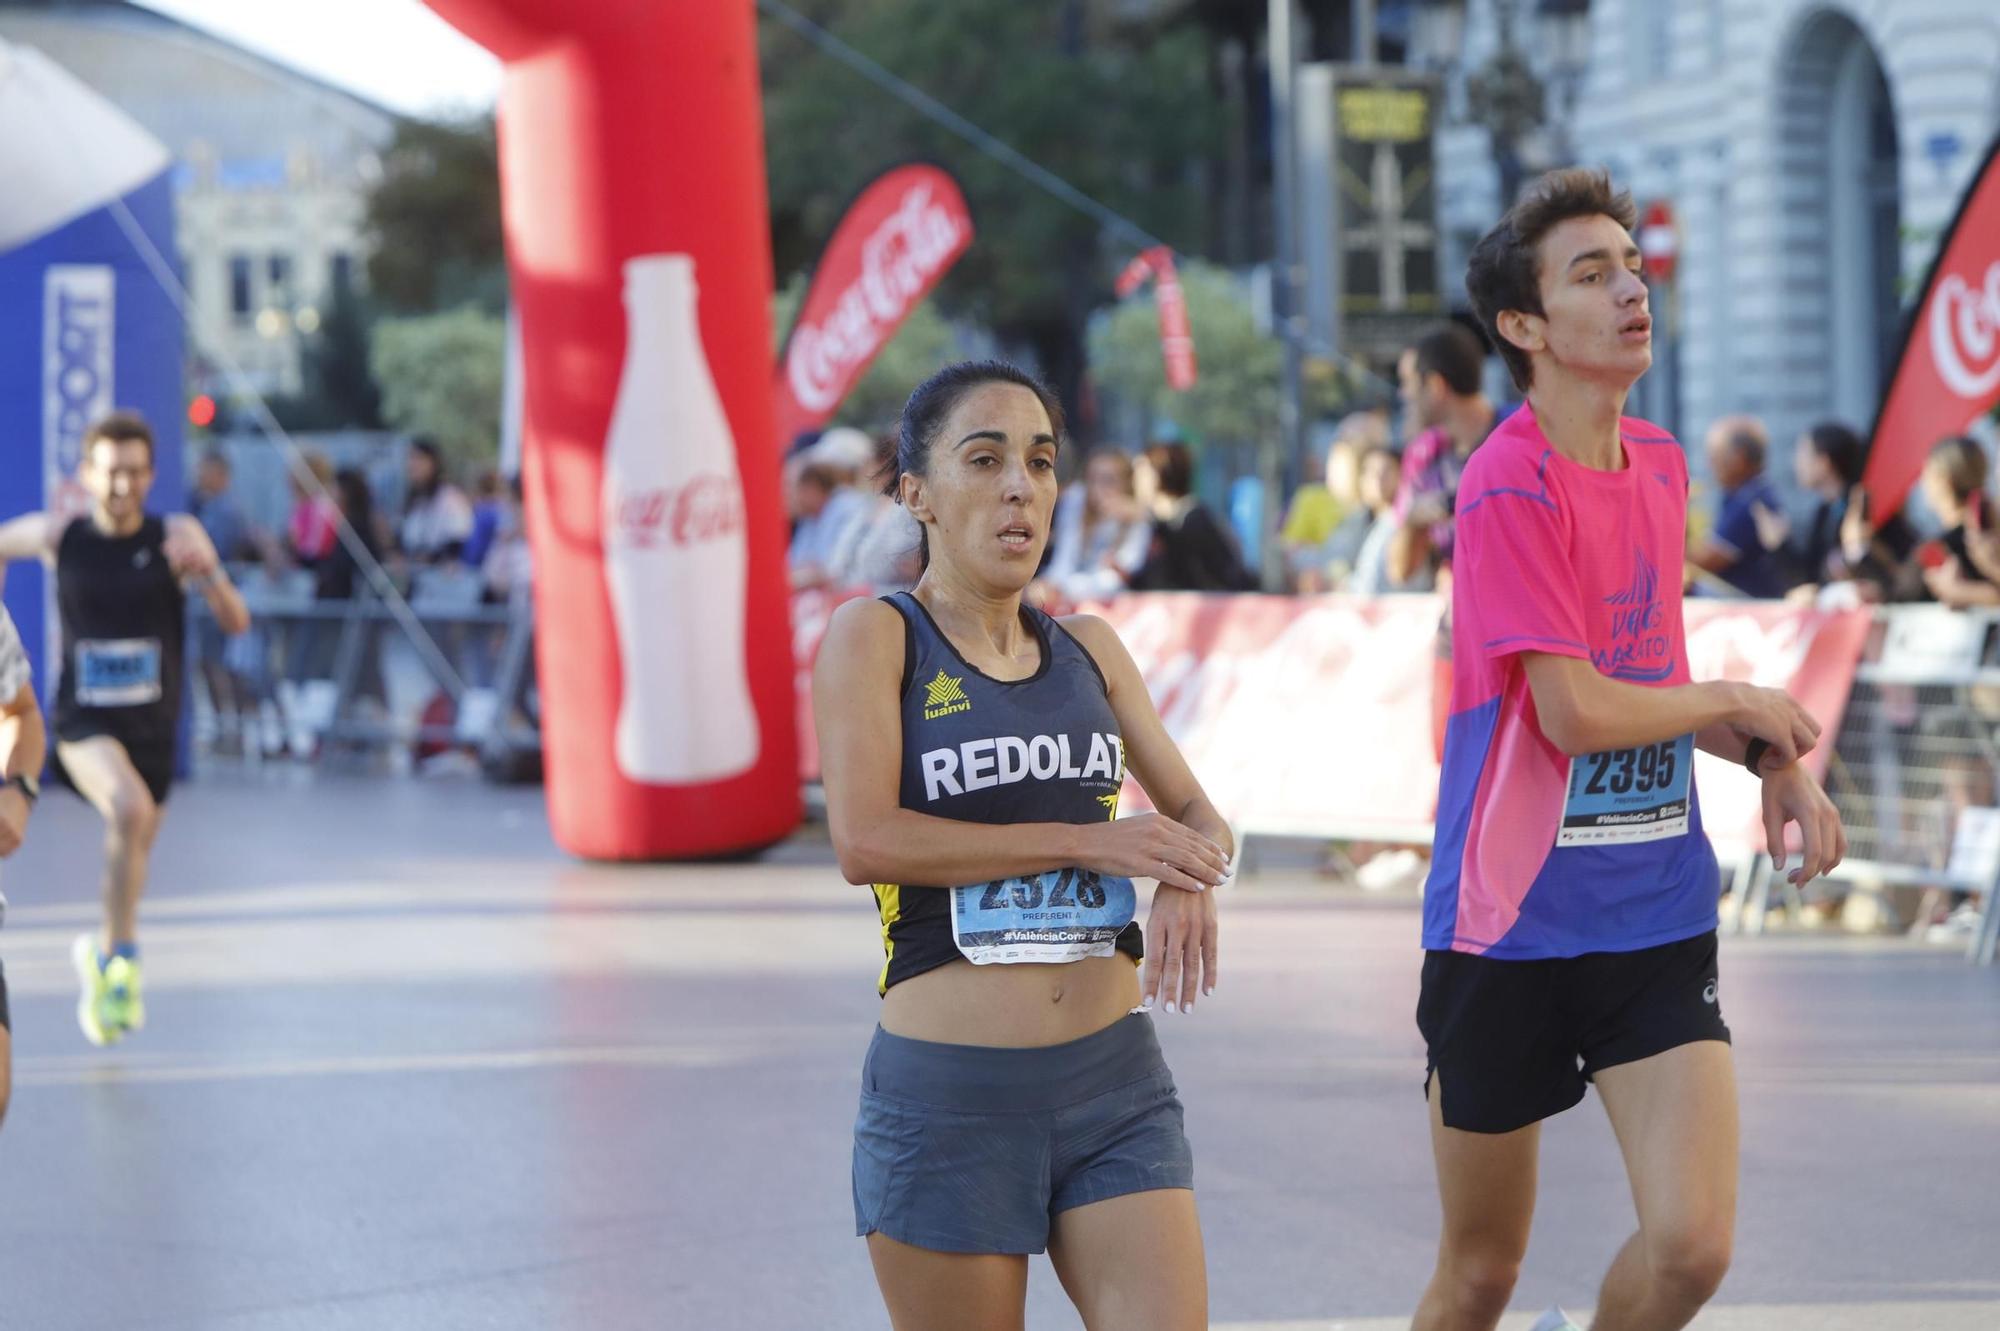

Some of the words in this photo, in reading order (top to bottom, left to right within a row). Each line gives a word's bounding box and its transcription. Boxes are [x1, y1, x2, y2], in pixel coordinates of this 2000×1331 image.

[924, 701, 971, 720] luanvi
[1584, 741, 1676, 794] 2395
[1022, 912, 1072, 921] PREFERENT
